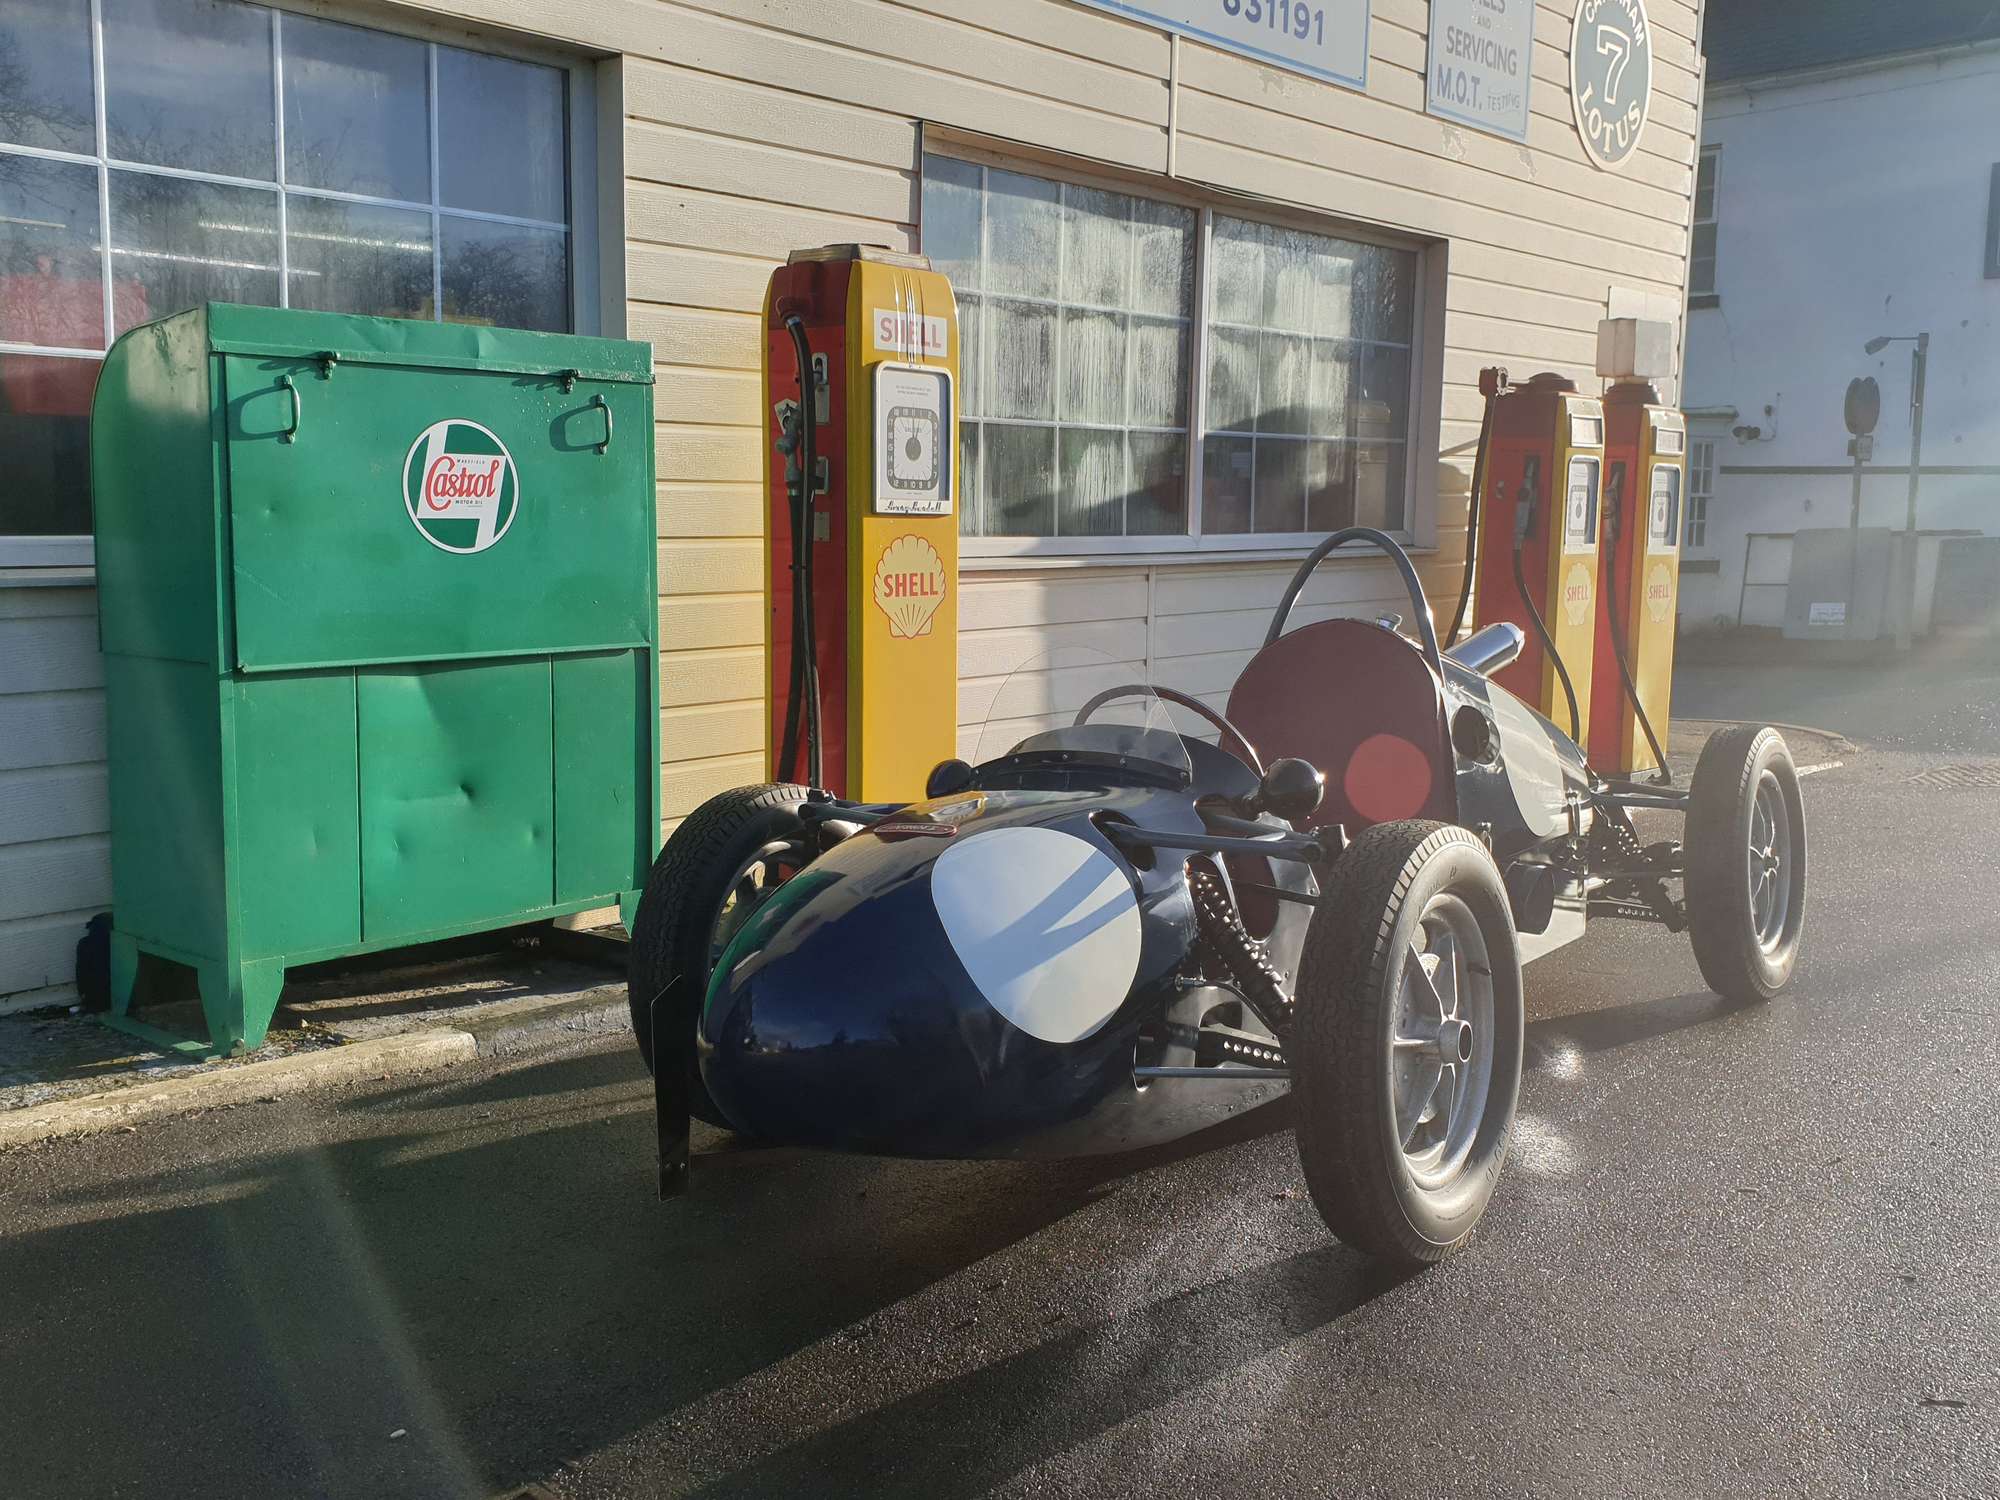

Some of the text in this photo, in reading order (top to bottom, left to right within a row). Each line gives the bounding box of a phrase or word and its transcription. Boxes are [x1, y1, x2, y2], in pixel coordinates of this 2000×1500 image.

[1446, 26, 1517, 76] SERVICING
[1597, 24, 1630, 105] 7
[1437, 64, 1482, 110] M.O.T.
[1580, 81, 1641, 153] LOTUS
[880, 317, 942, 348] SHELL
[425, 456, 500, 511] Castrol
[884, 572, 938, 598] SHELL
[1567, 584, 1588, 601] SHELL
[1649, 584, 1670, 600] SHELL
